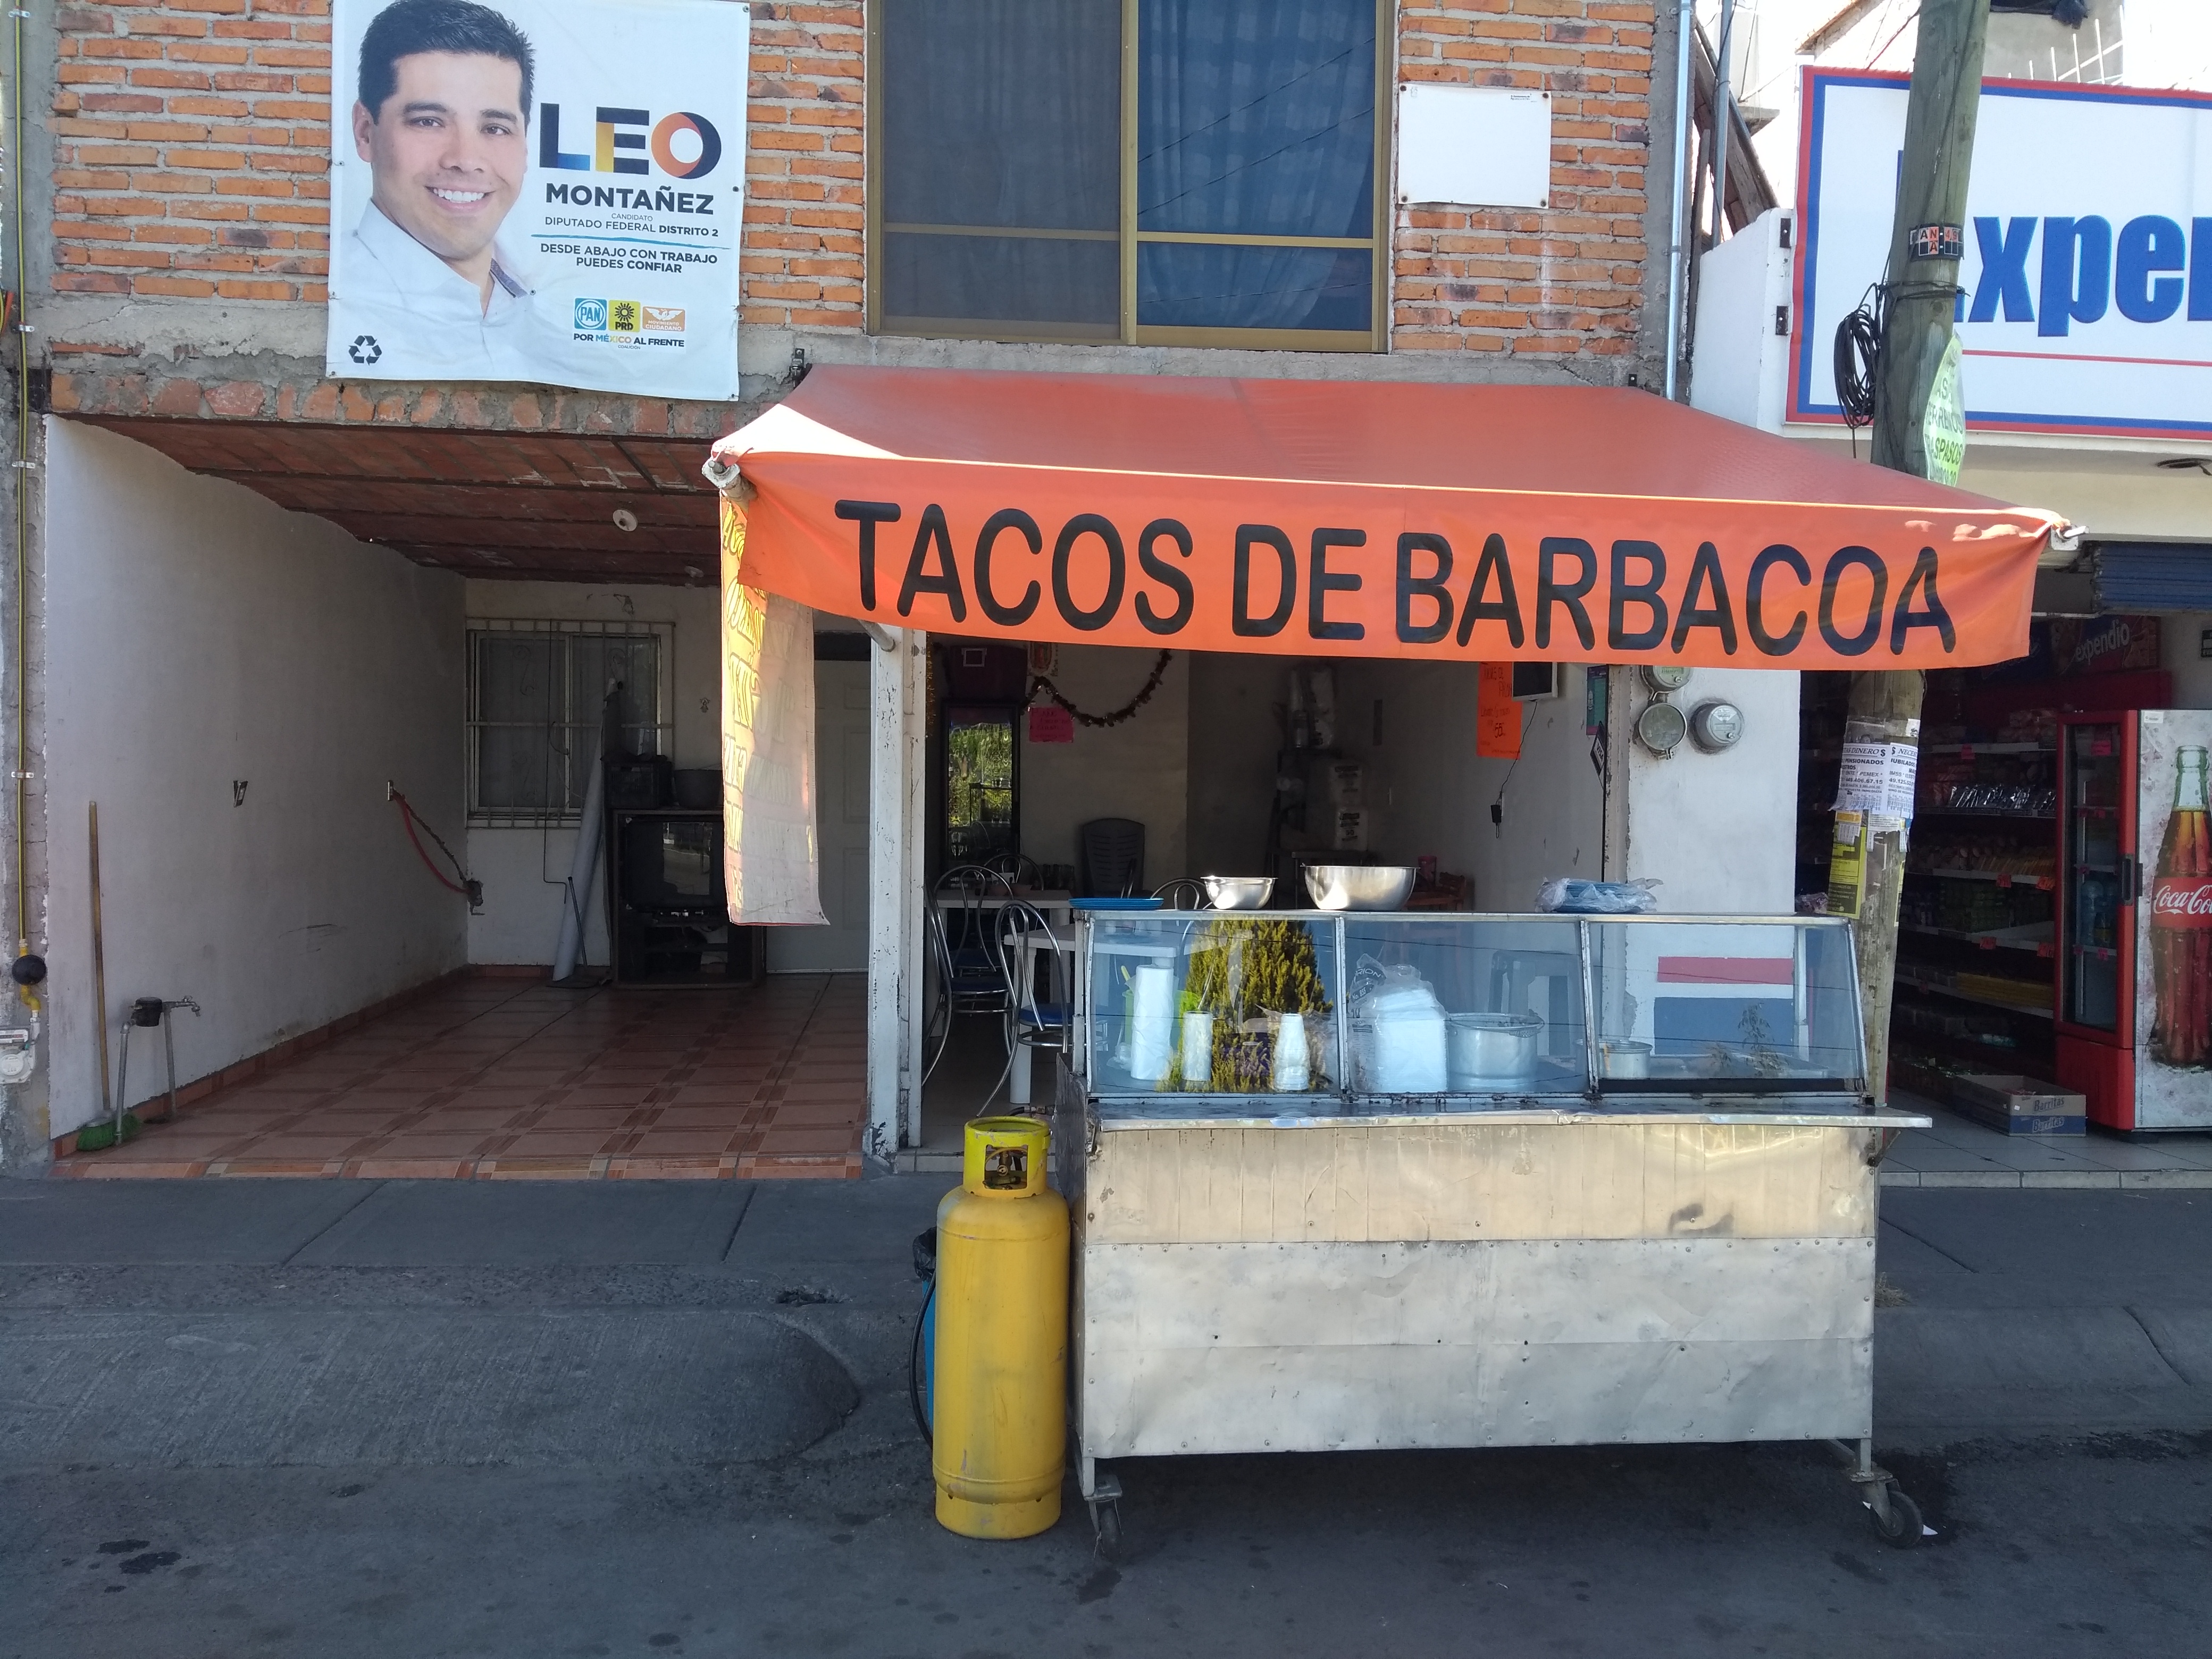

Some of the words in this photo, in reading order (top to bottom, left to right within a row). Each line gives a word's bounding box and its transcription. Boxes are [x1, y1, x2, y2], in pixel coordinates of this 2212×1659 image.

[539, 102, 722, 179] LEO
[546, 183, 714, 215] MONTAÑEZ
[611, 213, 653, 222] CANDIDATO
[545, 216, 602, 229] DIPUTADO
[606, 221, 656, 233] FEDERAL
[659, 225, 709, 236] DISTRITO
[540, 243, 581, 254] DESDE
[584, 246, 626, 257] ABAJO
[630, 249, 657, 259] CON
[660, 251, 717, 264] TRABAJO
[576, 257, 624, 269] PUEDES
[627, 261, 682, 273] CONFIAR
[580, 306, 600, 322] PAN
[615, 321, 634, 331] PRD
[573, 333, 593, 341] POR
[596, 333, 632, 343] MÉXICO
[648, 338, 684, 347] FRENTE
[835, 499, 1194, 635] TACOS
[1232, 524, 1367, 640] DE
[1396, 532, 1956, 656] BARBACOA
[2075, 618, 2131, 665] expendio
[1596, 742, 1604, 761] VISA
[1880, 749, 1886, 757] $
[1891, 747, 1896, 755] $
[1355, 968, 1381, 978] RION
[2034, 1097, 2064, 1112] Barritas
[2033, 1117, 2064, 1133] Barritas
